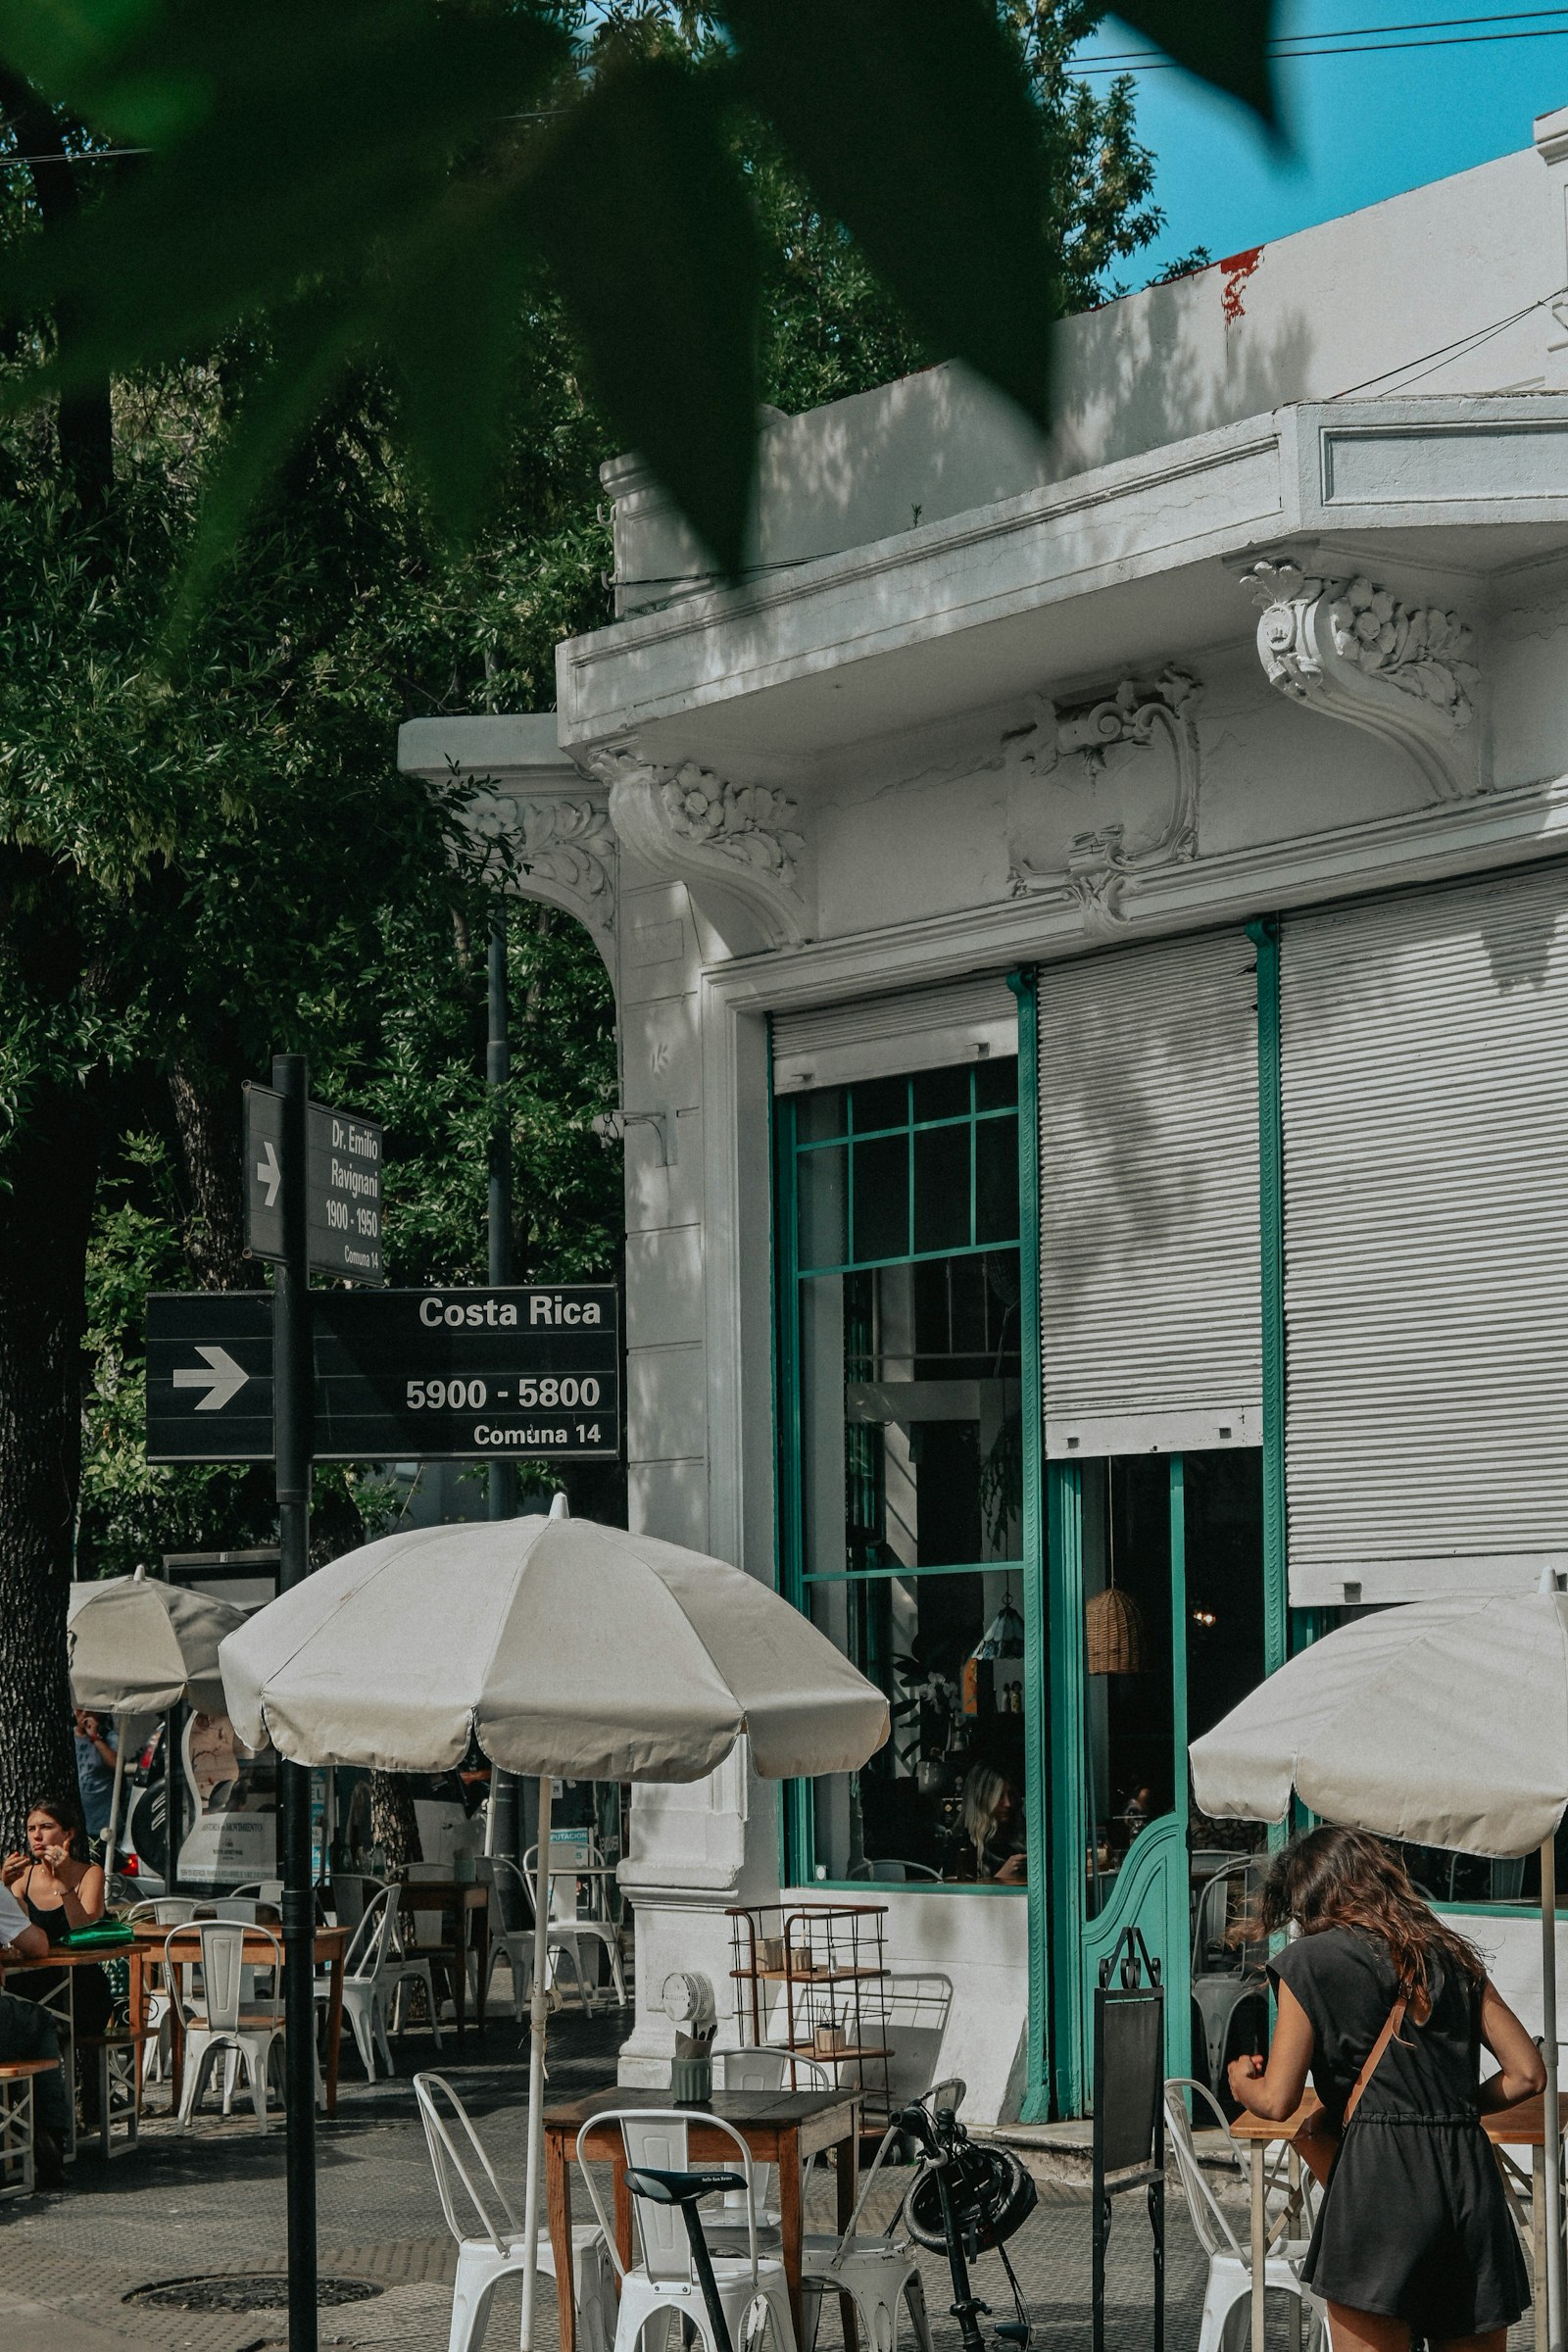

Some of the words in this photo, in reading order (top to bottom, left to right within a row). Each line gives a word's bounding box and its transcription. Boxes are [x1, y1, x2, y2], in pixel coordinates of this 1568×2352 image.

[332, 1119, 346, 1151] Dr.
[348, 1125, 378, 1160] Emilio
[331, 1157, 378, 1200] Ravignani
[325, 1199, 348, 1231] 1900
[356, 1207, 378, 1238] 1950
[344, 1245, 370, 1268] Comuna
[370, 1251, 379, 1270] 14
[419, 1297, 518, 1327] Costa
[529, 1295, 601, 1325] Rica
[406, 1379, 487, 1409] 5900
[518, 1377, 601, 1408] 5800
[473, 1424, 567, 1446] Comuna
[575, 1424, 602, 1444] 14
